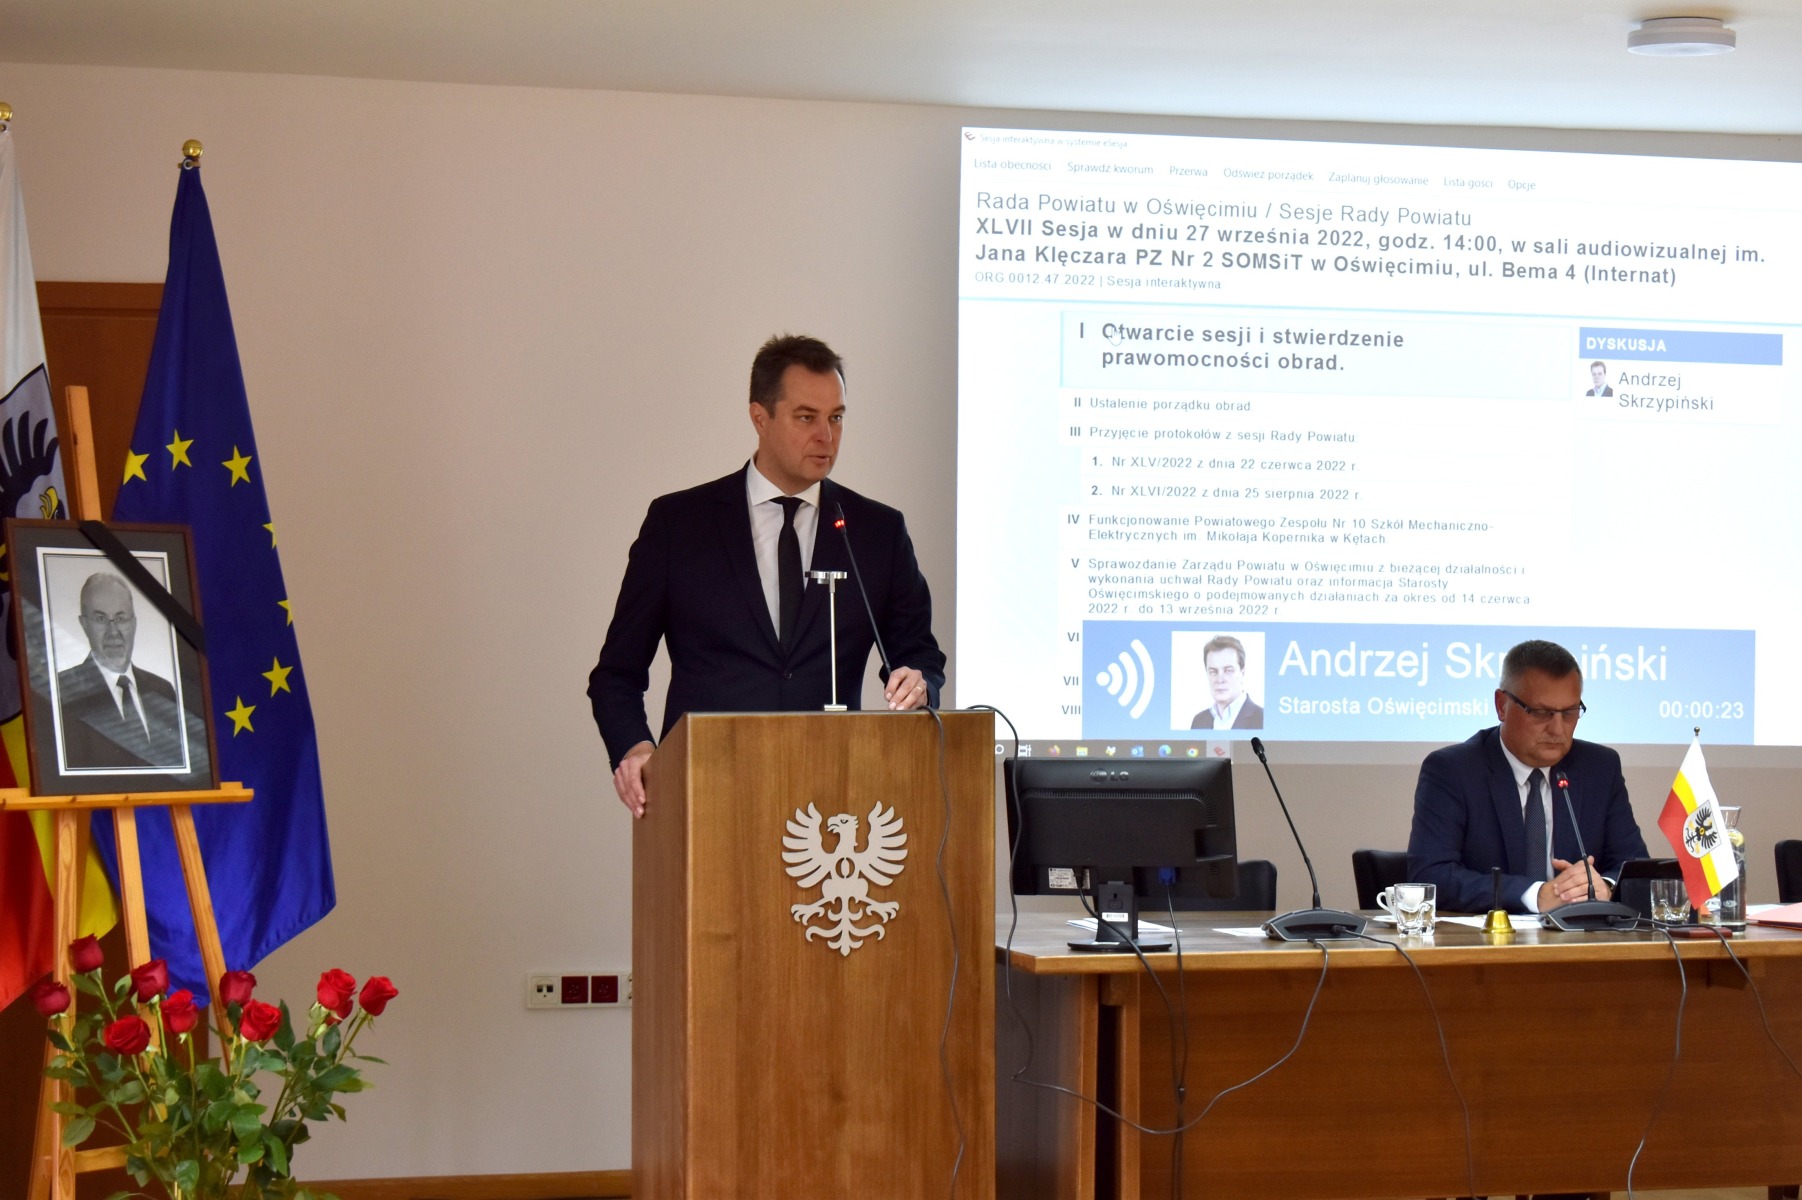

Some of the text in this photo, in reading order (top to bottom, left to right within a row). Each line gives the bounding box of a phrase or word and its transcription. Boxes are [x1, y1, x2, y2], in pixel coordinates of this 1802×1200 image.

[974, 158, 997, 169] Lista
[1114, 164, 1153, 174] kworum
[1169, 166, 1208, 177] Przerwa
[1268, 169, 1314, 183] porządek
[1328, 172, 1429, 186] Zaplanuj głosowanie
[1443, 177, 1465, 187] Lista
[1507, 179, 1536, 191] Opcje
[977, 192, 1471, 226] Rada Powiatu w Oświęcimiu / Sesje Rady Powiatu
[976, 217, 1765, 264] XLVII Sesja w dniu 27 września 2022, godz. 14:00, w sali audiowizualnej im.
[976, 245, 1676, 287] Jana Klęczara PZ Nr 2 SOMSiT w Oświęcimiu, ul. Bema 4 (Internat)
[1107, 275, 1142, 288] Sesja
[1146, 278, 1221, 290] interaktywna
[1079, 322, 1404, 348] I Otwarcie sesji i stwierdzenie
[1586, 337, 1667, 352] DYSKUSJA
[1102, 351, 1345, 371] prawomocności obrad.
[1619, 372, 1682, 390] Andrzej
[1074, 397, 1081, 408] II
[1090, 398, 1148, 409] Ustalenie
[1153, 400, 1210, 412] porządku
[1619, 394, 1714, 412] Skrzypiński
[1070, 426, 1081, 437] III
[1090, 427, 1148, 440] Przyjęcie
[1154, 429, 1221, 440] protokołów
[1226, 431, 1232, 440] z
[1238, 430, 1265, 443] sesji
[1271, 430, 1302, 442] Rady
[1092, 456, 1103, 467] 1.
[1112, 457, 1125, 467] Nr
[1131, 457, 1192, 468] XLV/2022
[1197, 460, 1203, 468] z
[1209, 458, 1235, 469] dnia
[1241, 459, 1255, 469] 22
[1261, 460, 1312, 471] czerwca
[1316, 460, 1346, 471] 2022
[1091, 485, 1102, 496] 2.
[1111, 486, 1125, 496] Nr
[1130, 486, 1196, 497] XLVI/2022
[1202, 489, 1208, 497] z
[1213, 488, 1239, 498] dnia
[1245, 488, 1259, 498] 25
[1264, 490, 1314, 501] sierpnia
[1320, 489, 1349, 500] 2022
[1067, 514, 1080, 524] IV
[1089, 515, 1190, 527] Funkcjonowanie
[1195, 516, 1276, 529] Powiatowego
[1280, 518, 1327, 530] Zespołu
[1333, 518, 1346, 528] Nr
[1352, 519, 1365, 529] 10
[1371, 519, 1404, 529] Szkół
[1089, 529, 1178, 542] Elektrycznych
[1207, 531, 1257, 543] Mikołaja
[1262, 532, 1325, 544] Kopernika
[1330, 535, 1339, 543] w
[1071, 558, 1080, 568] V
[1089, 559, 1177, 571] Sprawozdanie
[1182, 559, 1232, 572] Zarządu
[1238, 561, 1285, 571] Powiatu
[1291, 562, 1299, 571] w
[1305, 561, 1374, 573] Oświęcimiu
[1378, 565, 1385, 573] z
[1390, 563, 1440, 576] bieżącej
[1445, 564, 1517, 575] działalności
[1089, 574, 1449, 590] wykonania uchwał Rady Powiatu oraz informacja Starosty
[1089, 588, 1530, 605] Oświęcimskiego o podejmowanych działaniach za okres od 14 czerwca
[1089, 603, 1118, 614] 2022
[1139, 603, 1153, 614] do
[1160, 604, 1173, 614] 13
[1179, 604, 1234, 615] września
[1239, 605, 1269, 615] 2022
[1067, 632, 1080, 642] VI
[1277, 640, 1430, 686] Andrzej
[1063, 676, 1079, 686] VII
[1277, 695, 1489, 719] Starosta Oświęcimski
[1658, 701, 1744, 719] 00:00:23
[1110, 771, 1129, 781] LG
